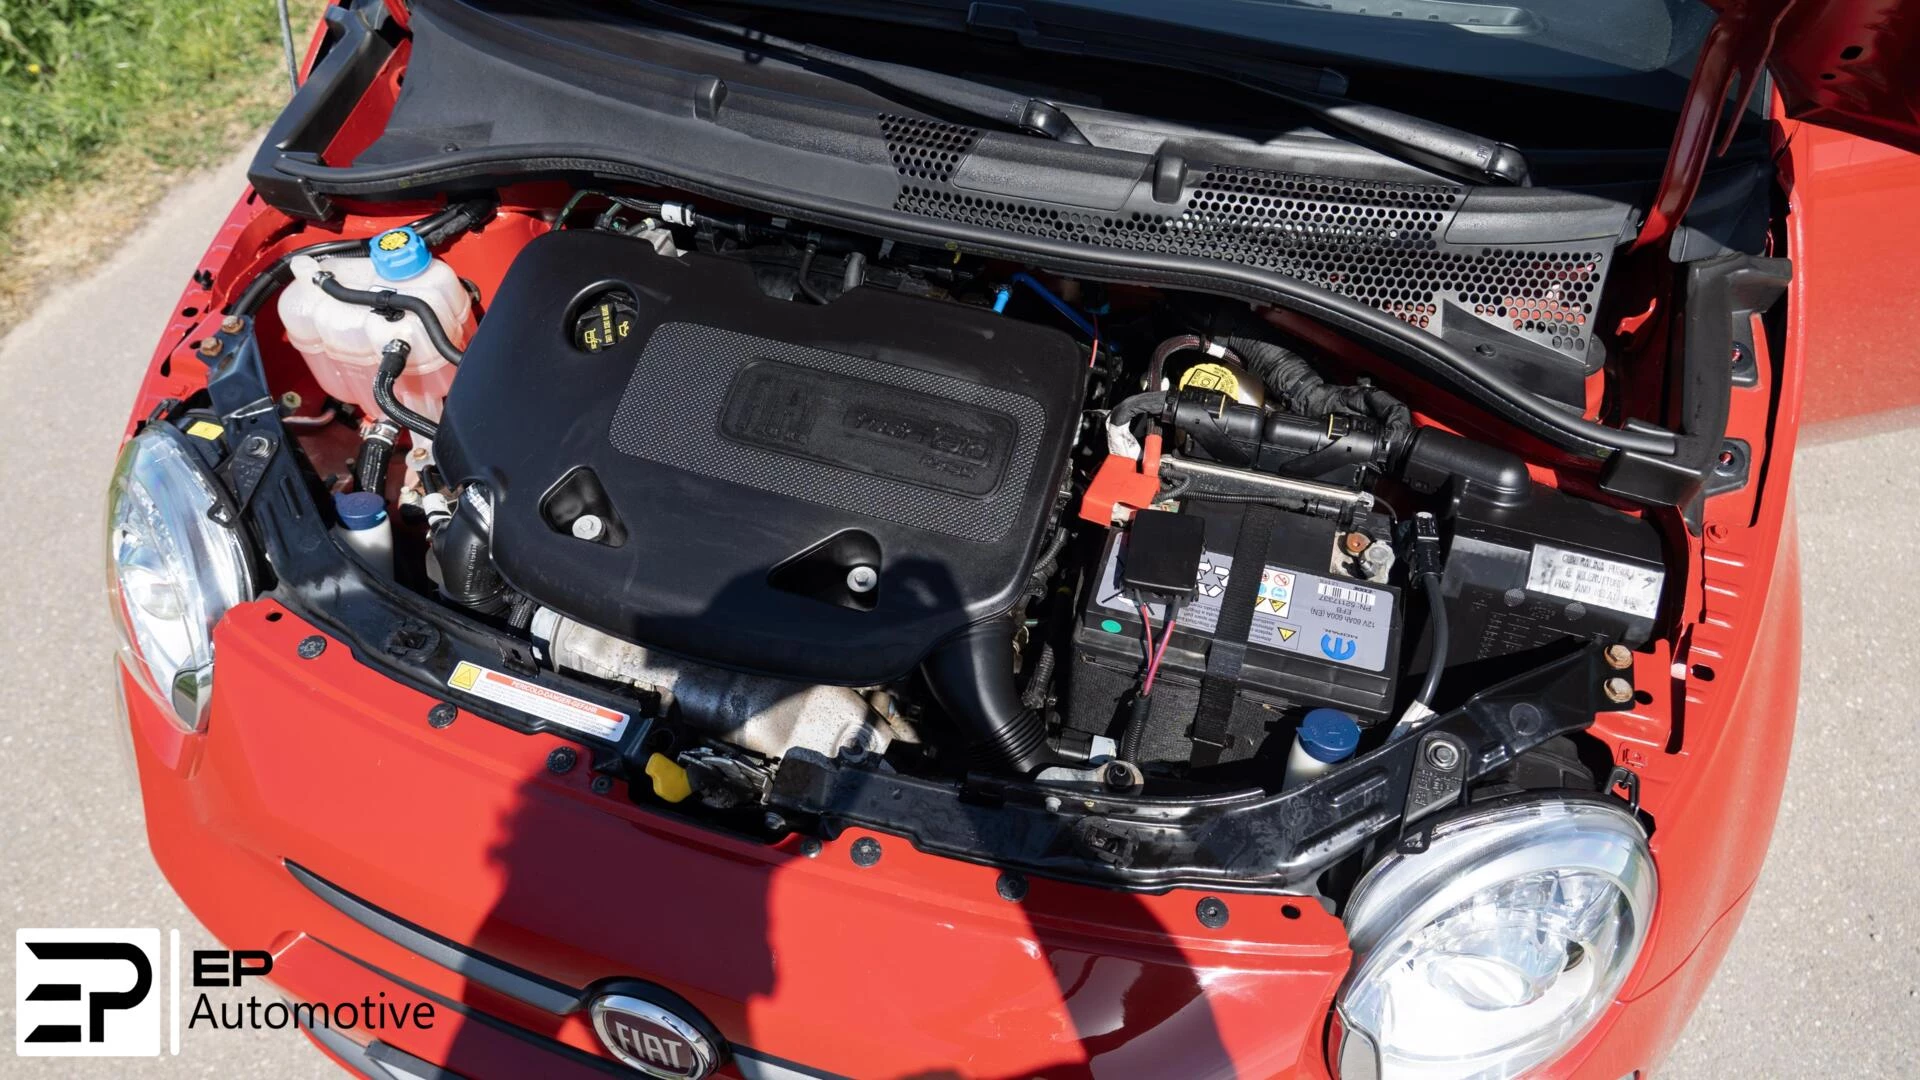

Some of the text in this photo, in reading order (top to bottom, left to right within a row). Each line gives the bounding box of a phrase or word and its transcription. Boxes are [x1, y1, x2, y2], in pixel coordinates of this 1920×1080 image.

[1310, 607, 1375, 628] 12V 60Ah 600A (EN)
[1335, 606, 1352, 615] EFB
[615, 1022, 682, 1068] FIAT
